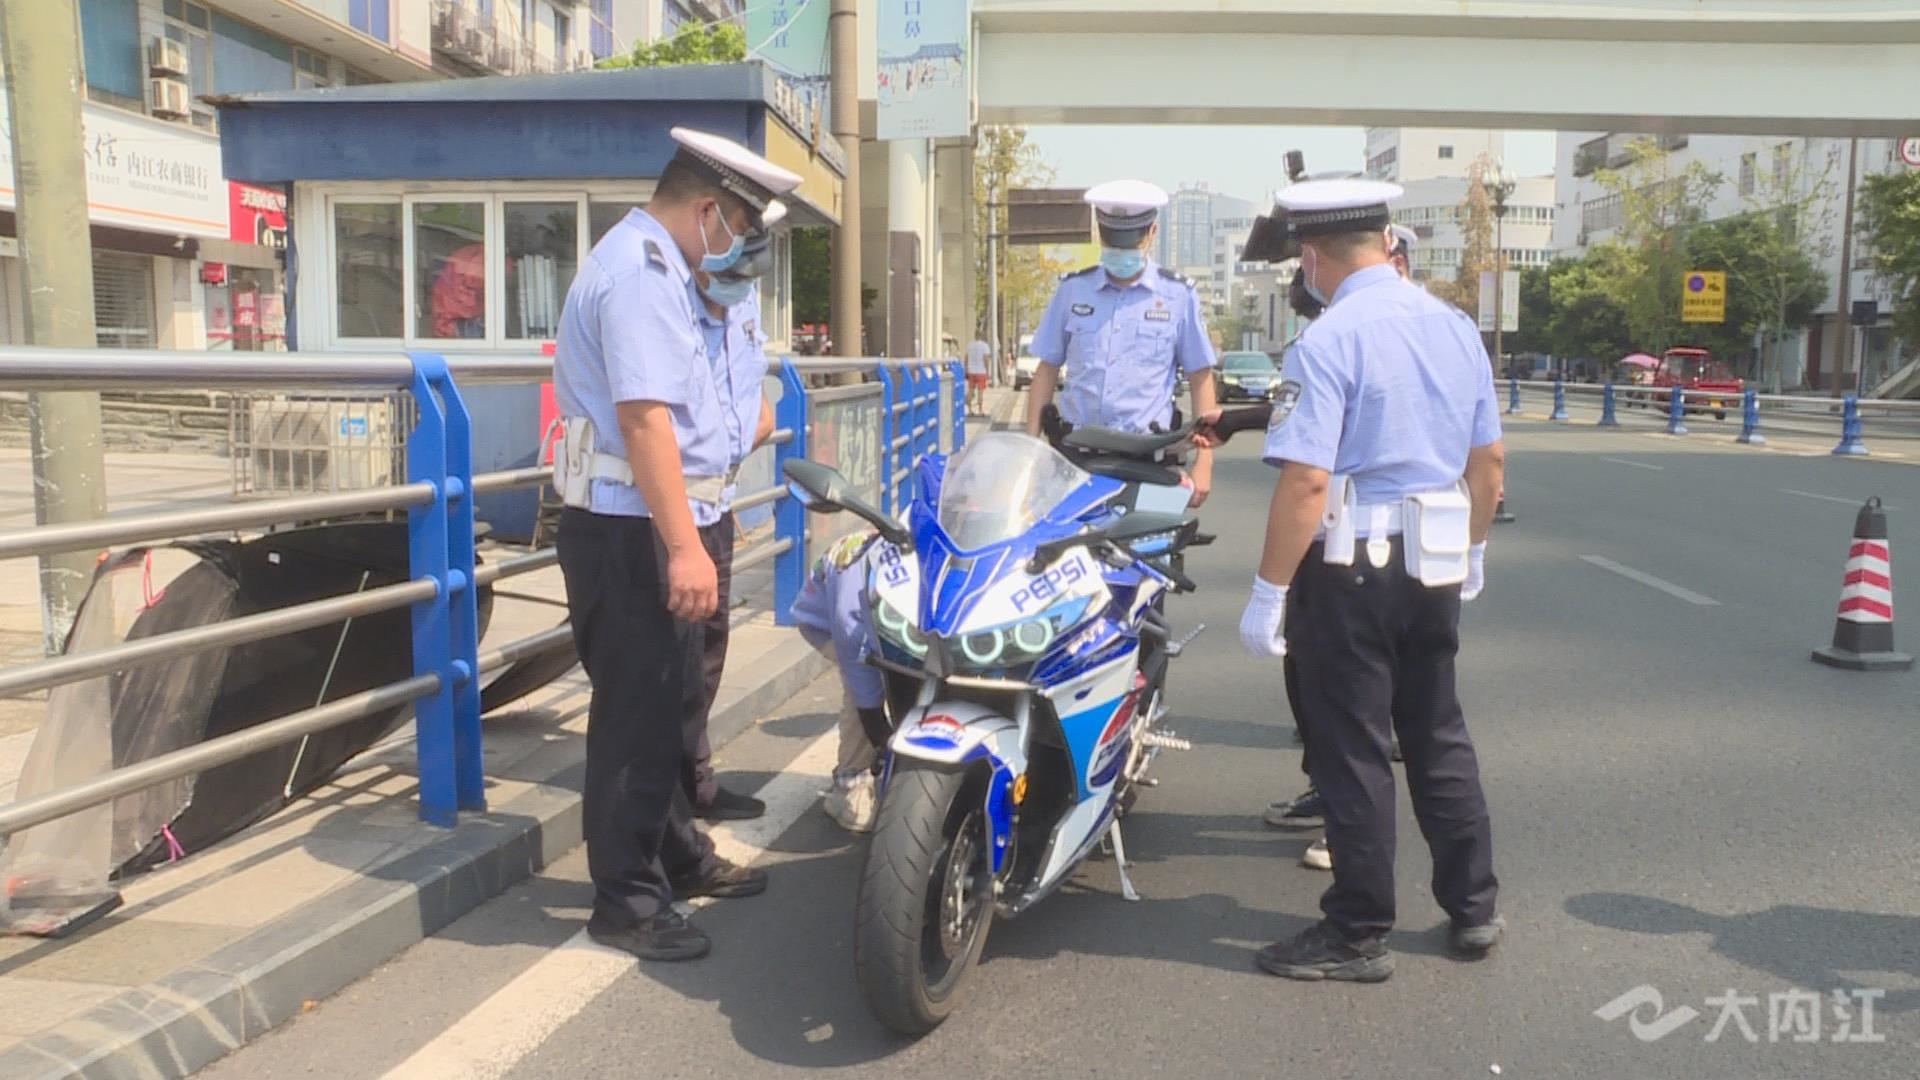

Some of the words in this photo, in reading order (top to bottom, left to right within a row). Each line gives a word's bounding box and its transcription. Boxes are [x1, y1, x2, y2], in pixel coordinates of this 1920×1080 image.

[128, 151, 208, 190] 内江农商银行
[1010, 556, 1087, 612] PEPSI
